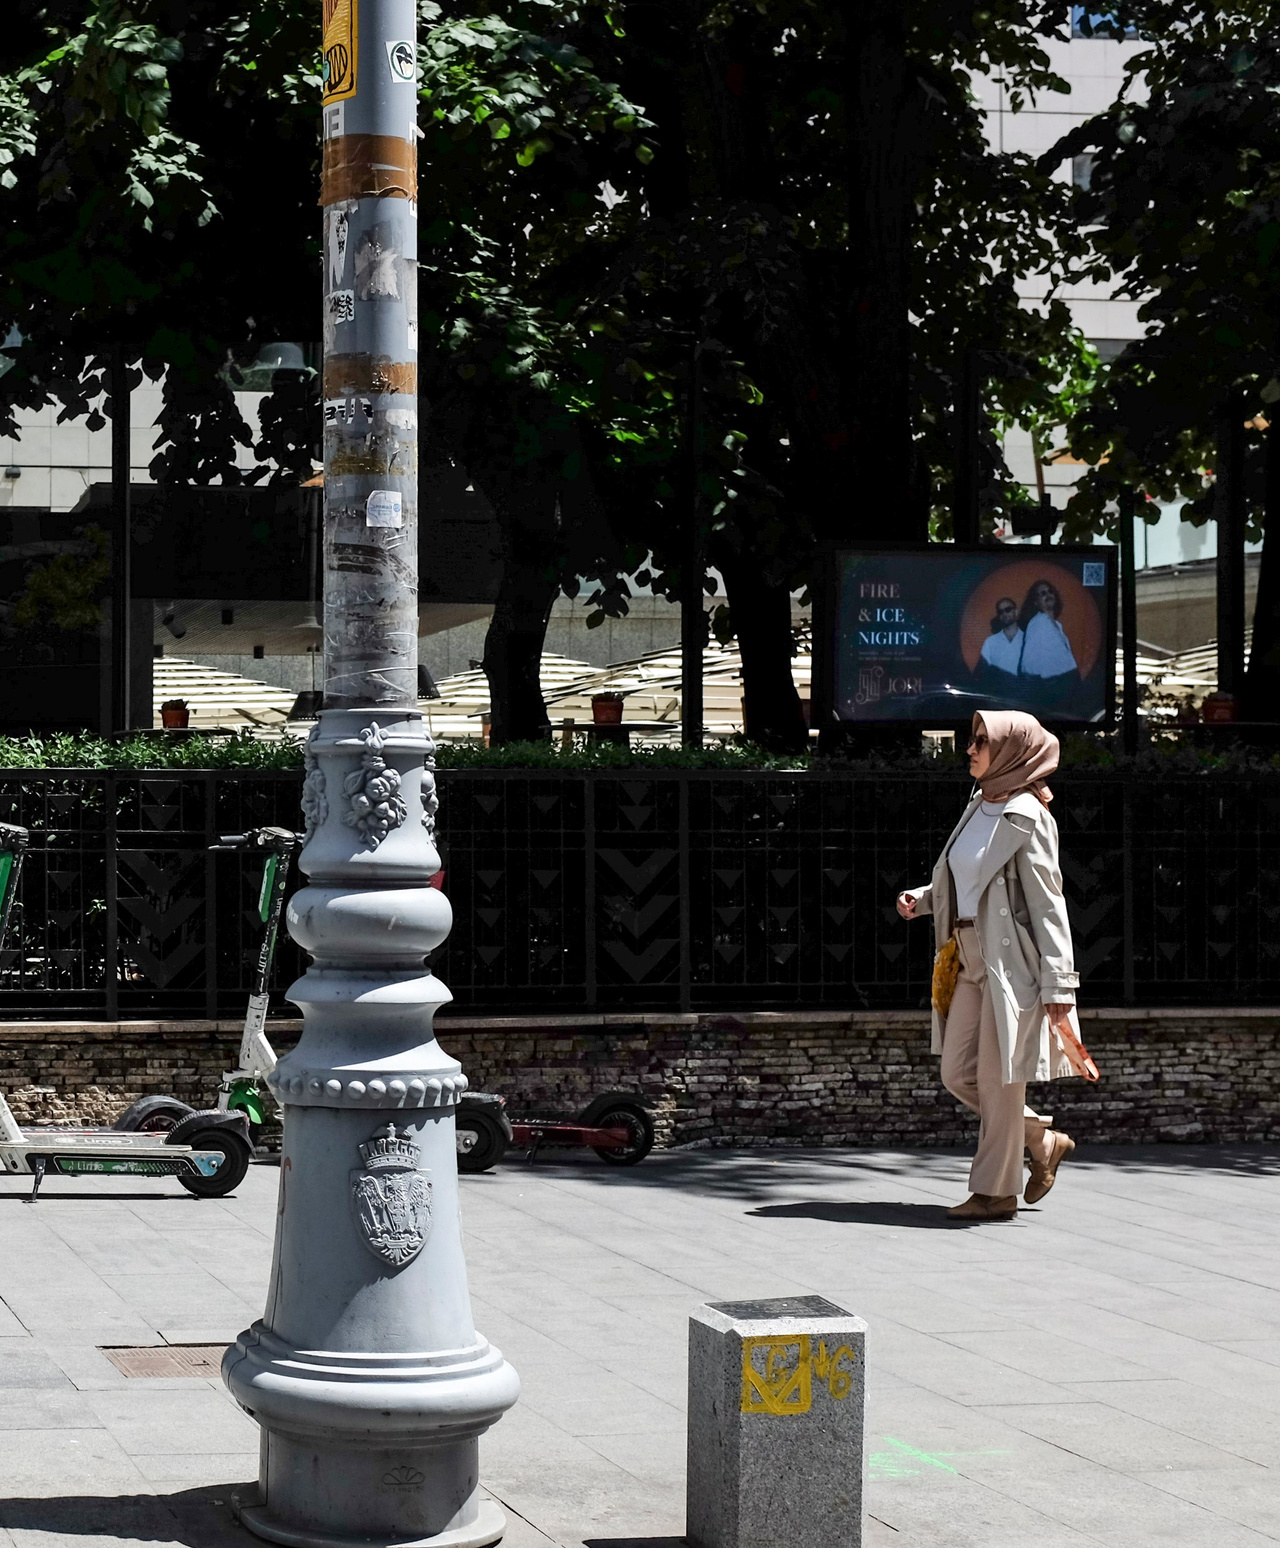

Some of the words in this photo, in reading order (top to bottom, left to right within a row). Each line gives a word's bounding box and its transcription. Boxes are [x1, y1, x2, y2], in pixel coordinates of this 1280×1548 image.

[860, 583, 900, 598] FIRE
[858, 608, 871, 622] &
[876, 608, 905, 622] ICE
[859, 631, 920, 645] NIGHTS
[77, 1161, 104, 1171] Lime
